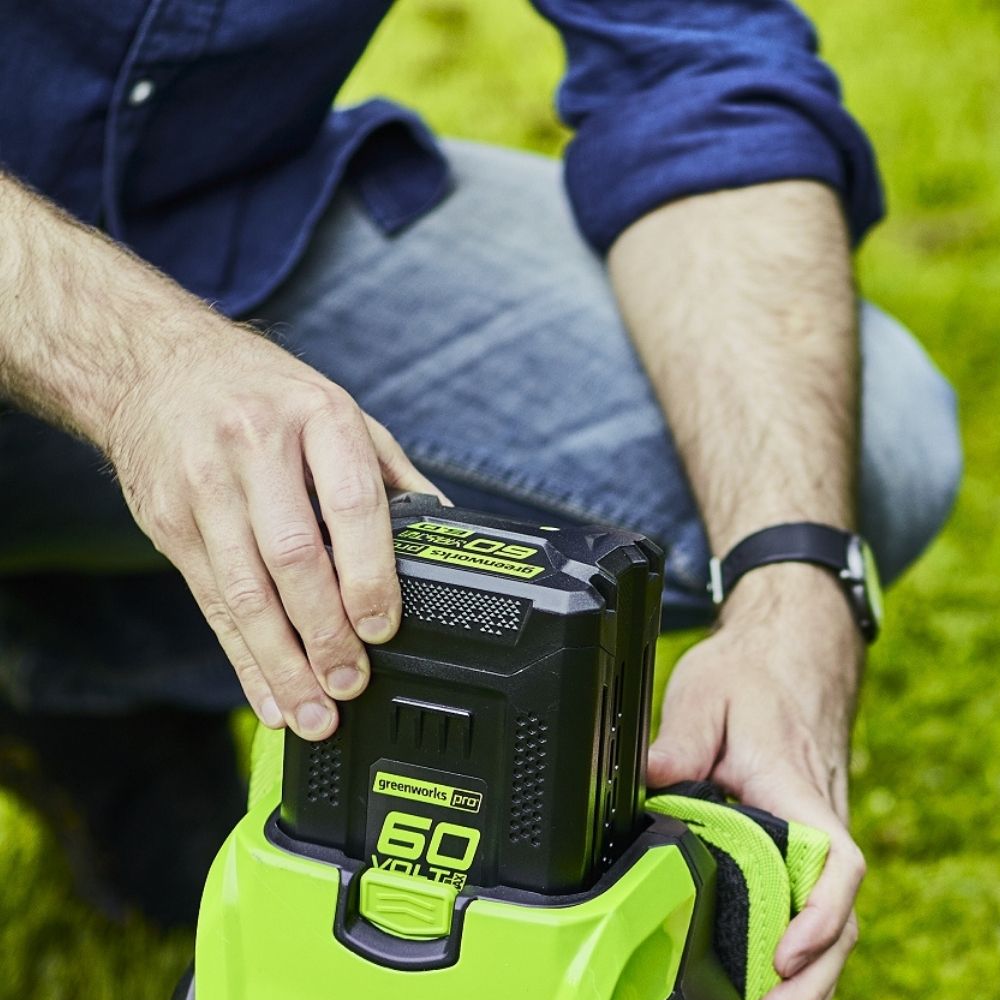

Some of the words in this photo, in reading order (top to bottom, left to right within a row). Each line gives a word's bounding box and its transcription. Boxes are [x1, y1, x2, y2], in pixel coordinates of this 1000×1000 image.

[429, 548, 536, 575] greenworks
[378, 777, 448, 801] greenworks
[452, 793, 479, 808] pro
[376, 811, 481, 871] 60
